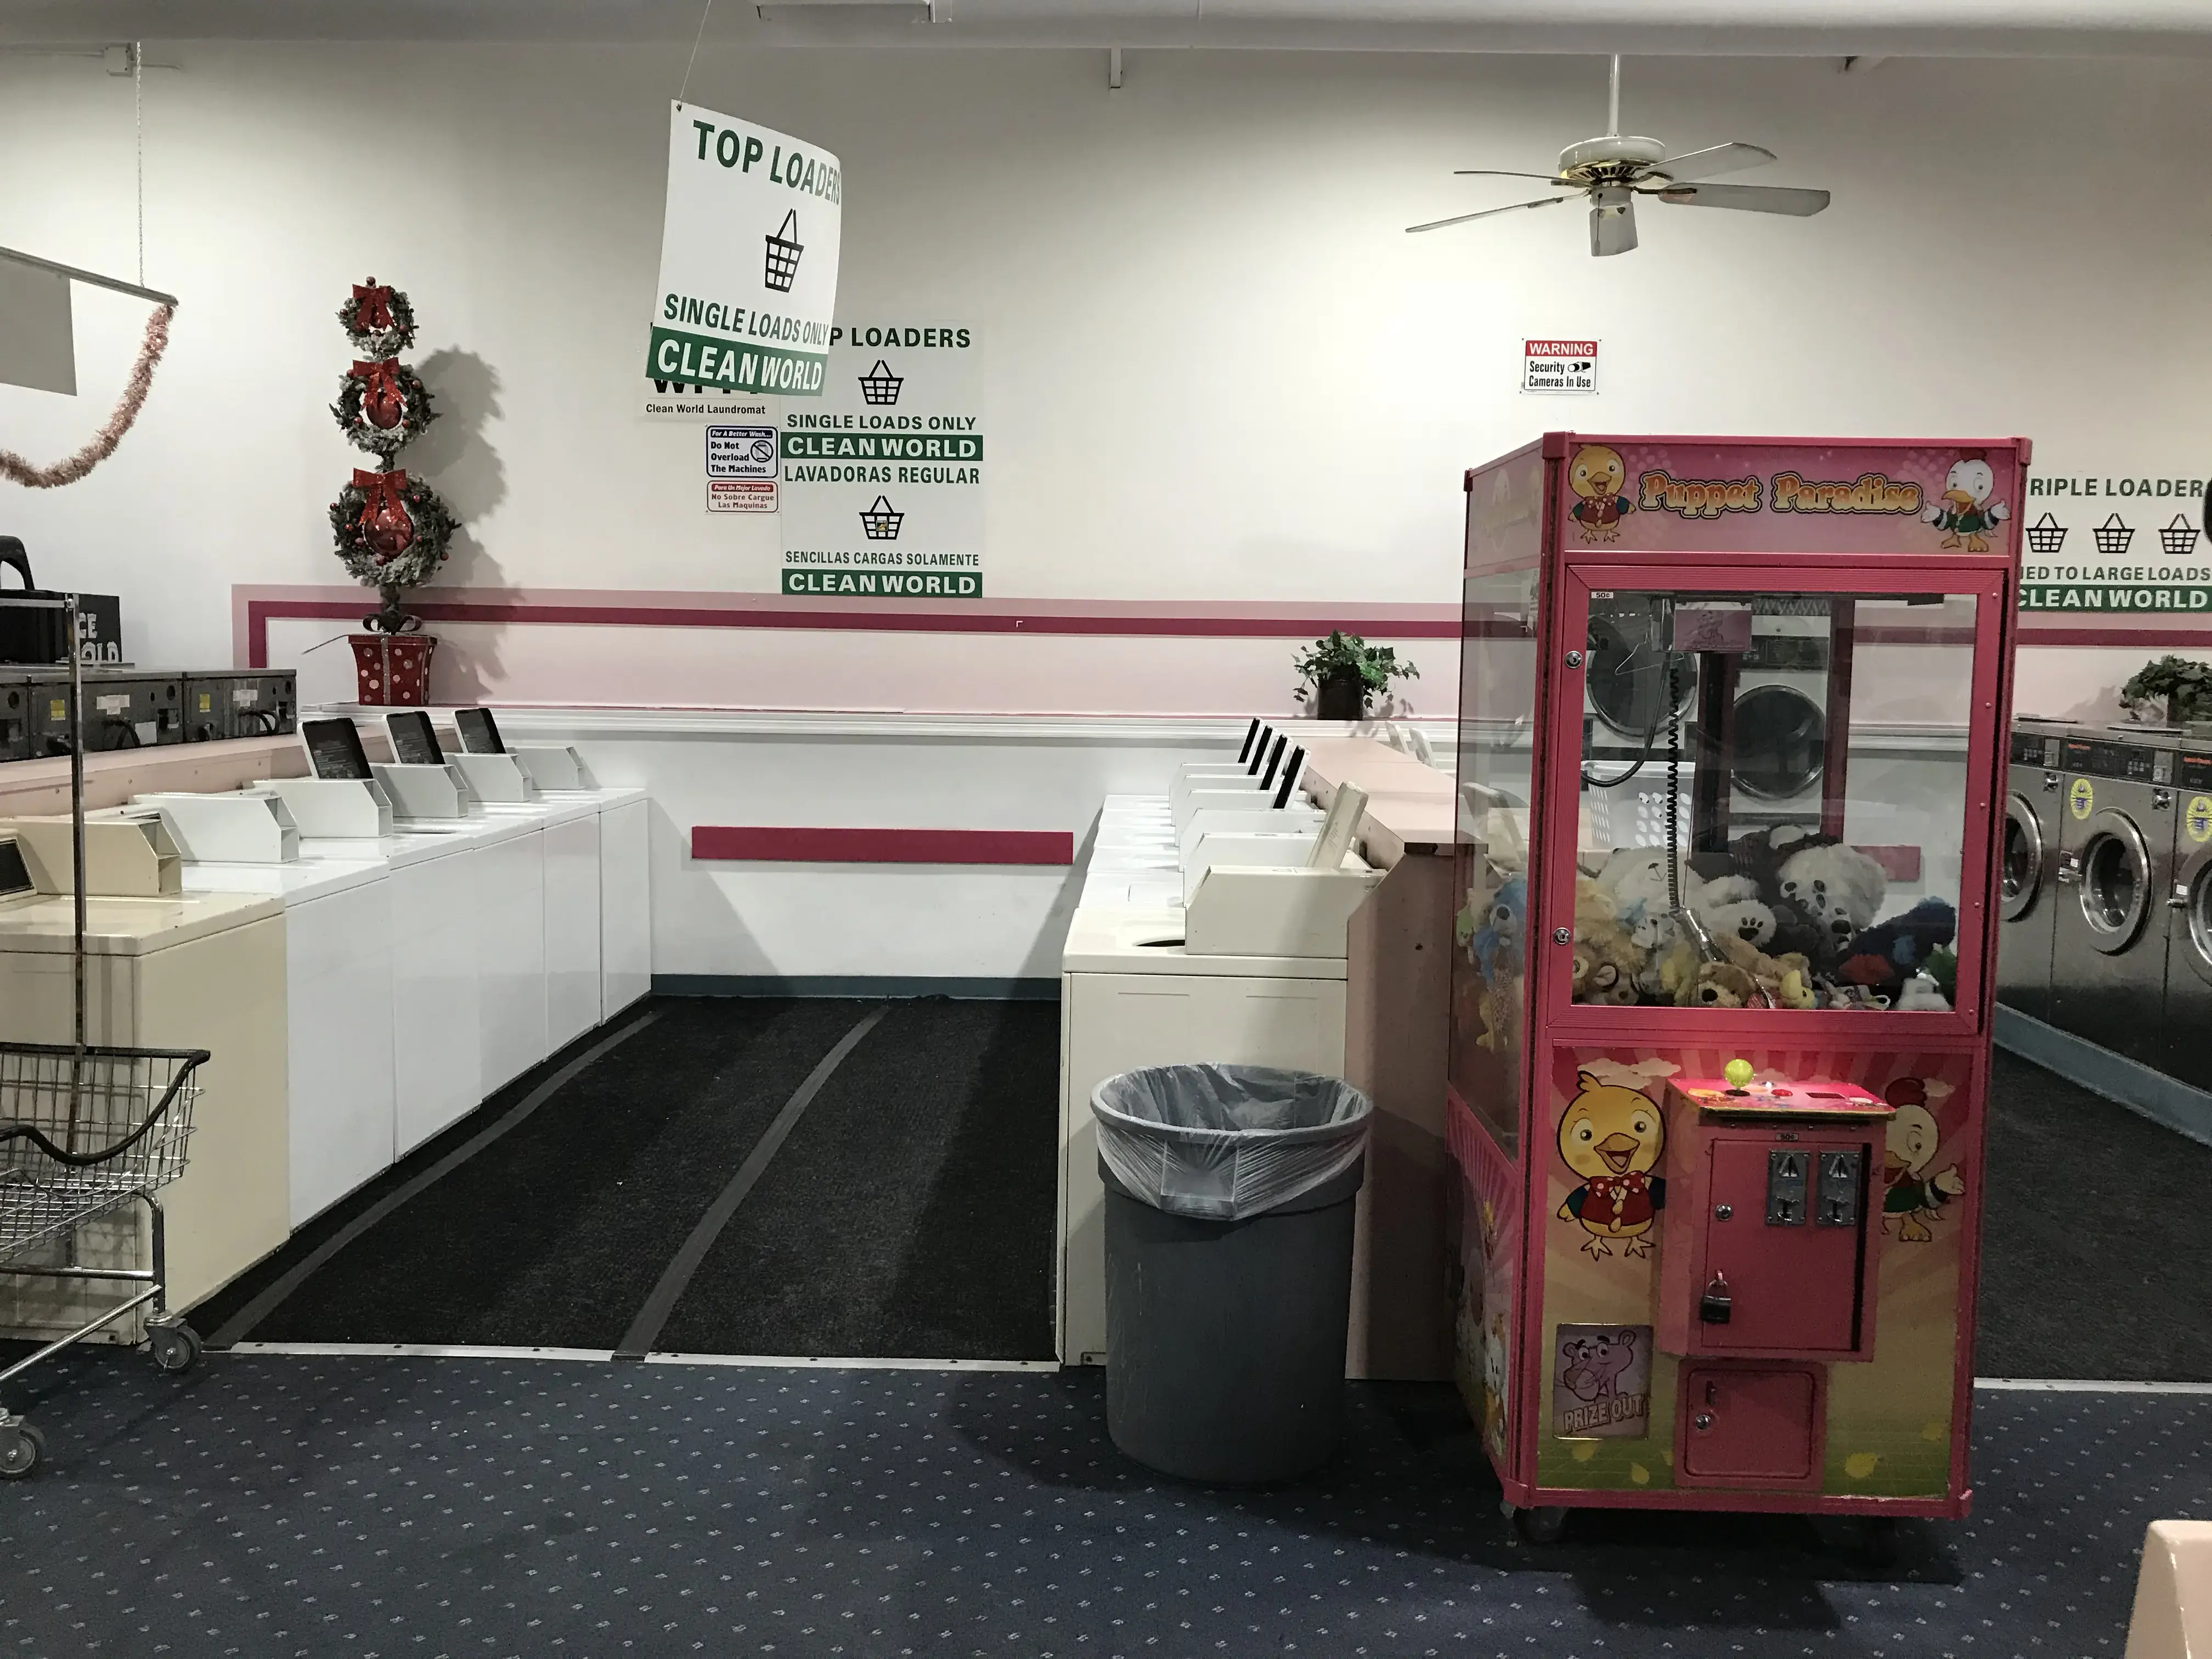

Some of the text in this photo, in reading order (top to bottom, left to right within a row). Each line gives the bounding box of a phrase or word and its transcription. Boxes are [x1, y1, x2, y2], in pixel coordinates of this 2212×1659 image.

[693, 119, 840, 205] TOP LOADERS
[664, 293, 746, 333] SINGLE
[748, 311, 800, 342] LOADS
[803, 320, 829, 346] ONLY
[852, 328, 970, 348] LOADERS
[1530, 343, 1593, 355] WARNING
[658, 339, 822, 390] CLEAN WORLD
[1530, 360, 1565, 375] Security
[1529, 375, 1591, 387] Cameras In Use
[646, 404, 766, 414] Clean World Laundromat
[787, 414, 977, 431] SINGLE LOADS ONLY
[787, 437, 977, 458] CLEAN WORLD
[711, 453, 749, 461] Overload
[785, 466, 979, 484] LAVADORAS REGULAR
[1640, 471, 1922, 517] Puppet Paradise
[2030, 478, 2203, 497] RIPLE LOADER
[785, 551, 979, 566] SENCILLAS CARGAS SOLAMENTE
[2054, 566, 2078, 580] TO
[2083, 567, 2143, 581] LARGE
[2148, 567, 2211, 581] LOADS
[788, 573, 976, 595] CLEAN WORLD
[2108, 590, 2208, 608] WORLD
[1564, 1393, 1645, 1433] PRIZE OUT
